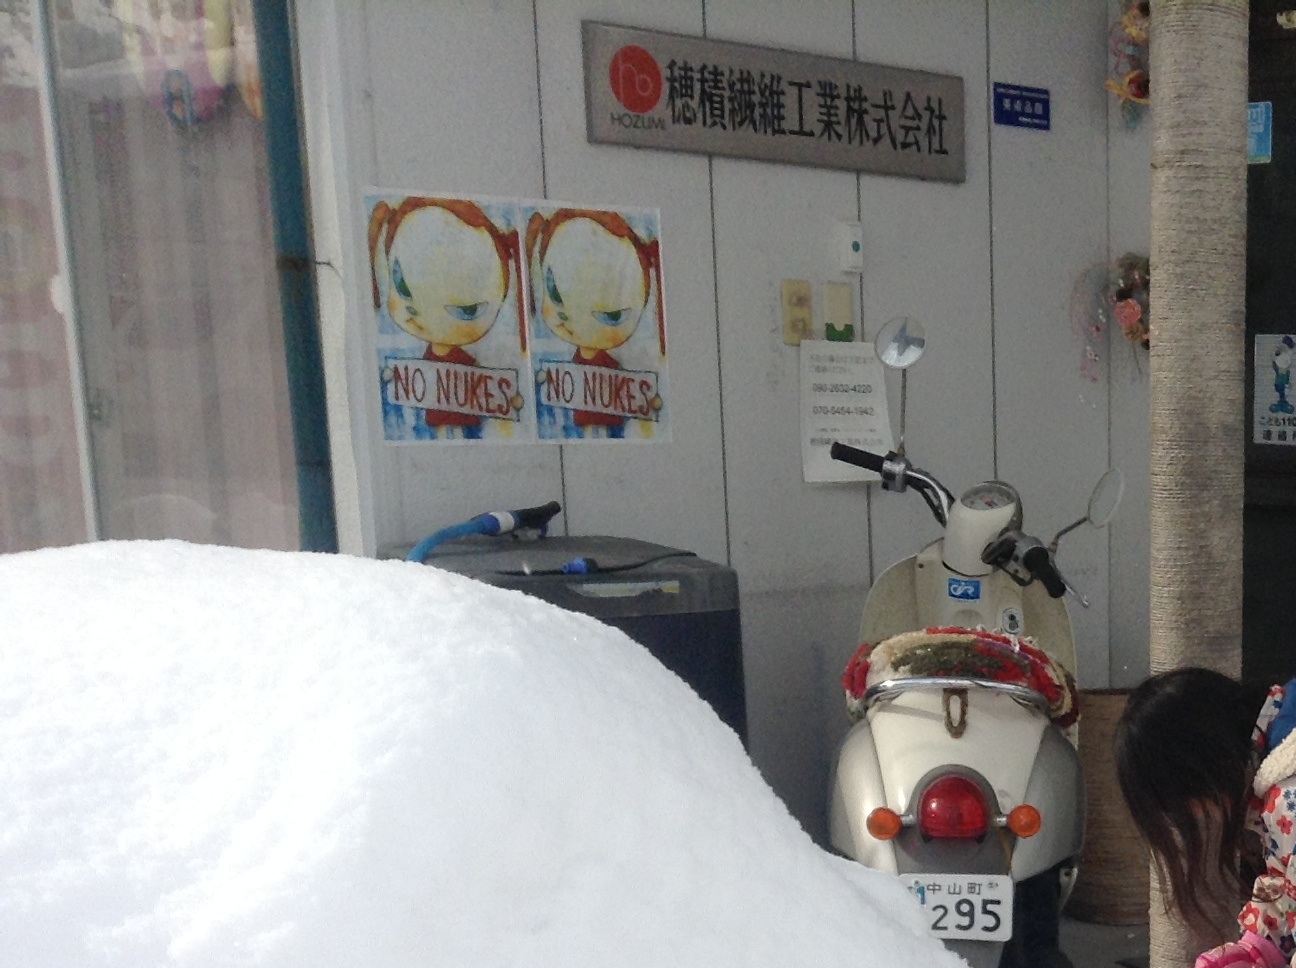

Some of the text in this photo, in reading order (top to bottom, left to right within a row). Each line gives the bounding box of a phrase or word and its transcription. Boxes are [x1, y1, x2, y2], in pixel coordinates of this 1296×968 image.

[610, 112, 666, 131] HOZUMI
[666, 59, 949, 155] 穂積繊維工業株式会社
[393, 364, 512, 416] NO NUKES
[546, 367, 653, 417] NO NUKES
[926, 882, 983, 896] 中山町
[931, 898, 1002, 933] 295
